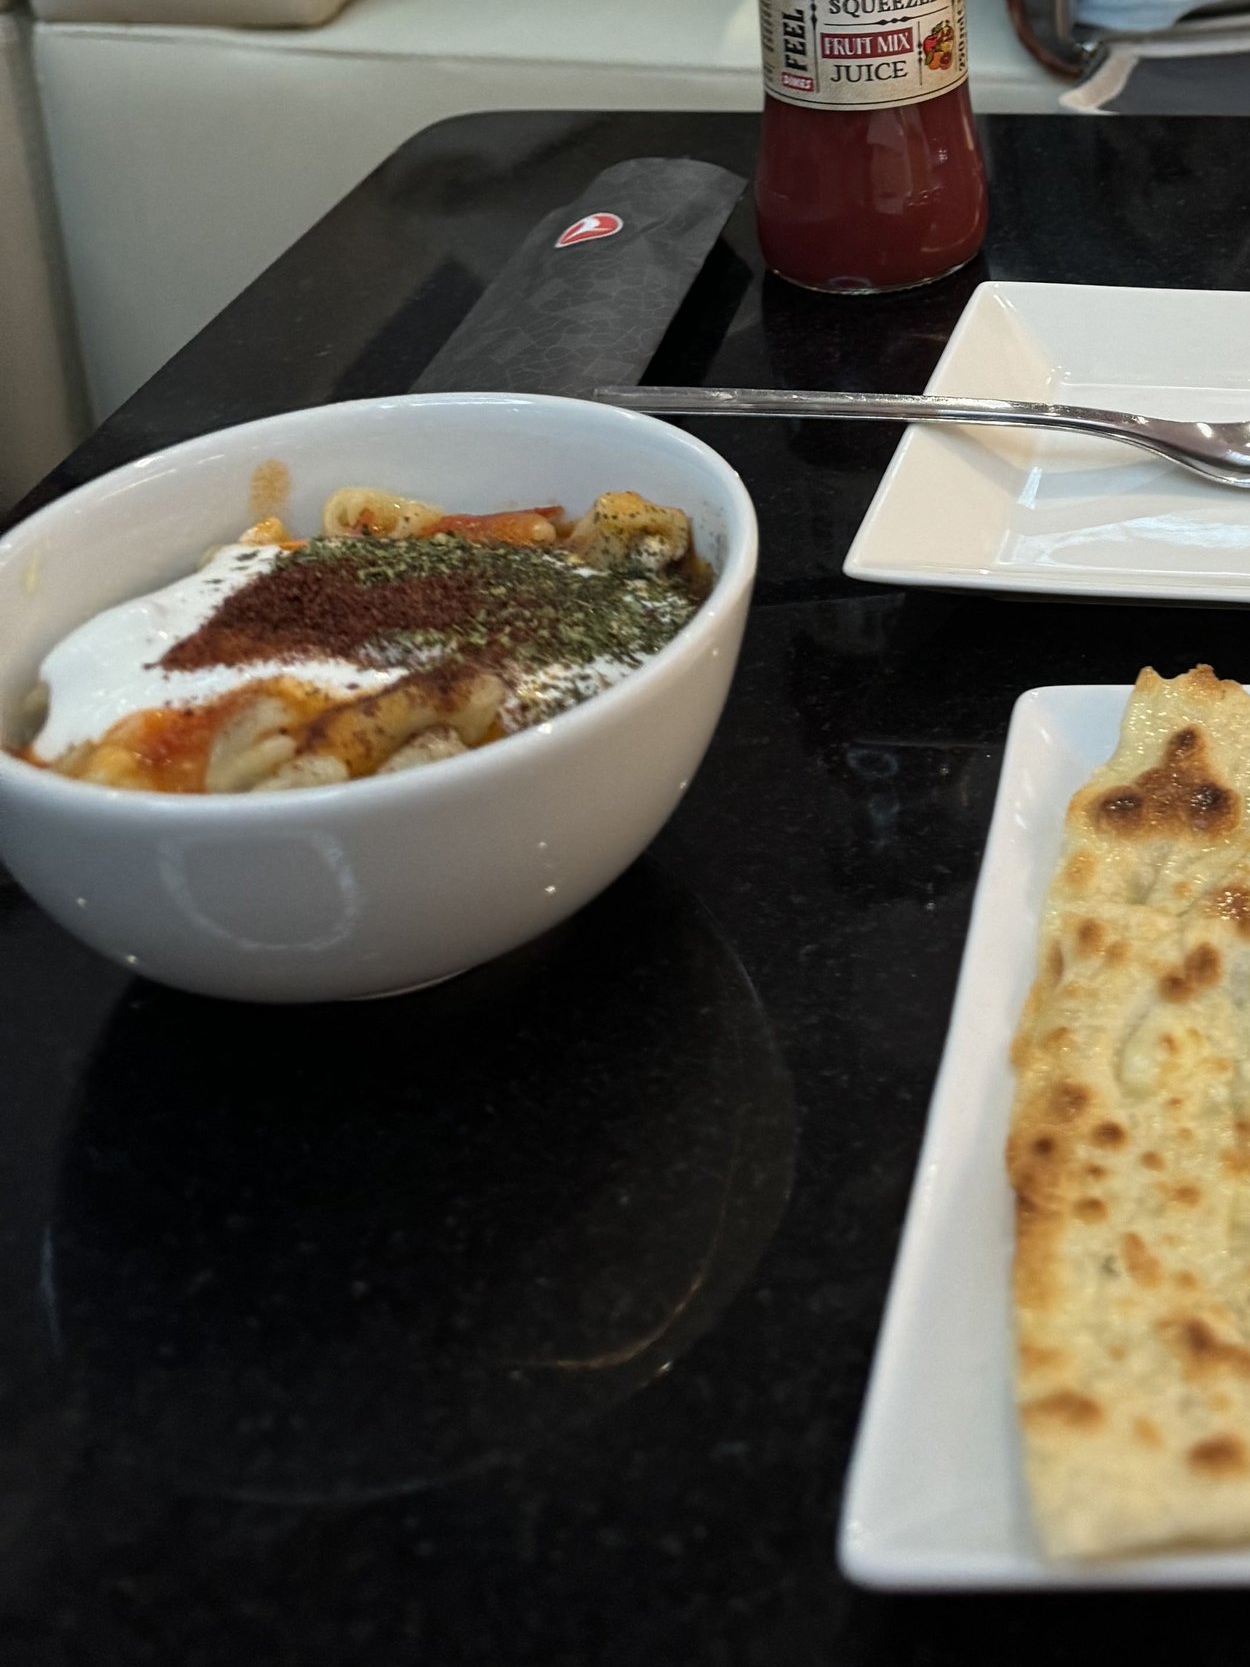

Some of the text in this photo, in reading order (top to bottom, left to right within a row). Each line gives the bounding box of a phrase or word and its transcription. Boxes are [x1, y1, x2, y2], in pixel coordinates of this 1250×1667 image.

[782, 8, 808, 72] FEEL
[823, 32, 910, 55] FRUIT MIX
[830, 61, 908, 82] JUICE
